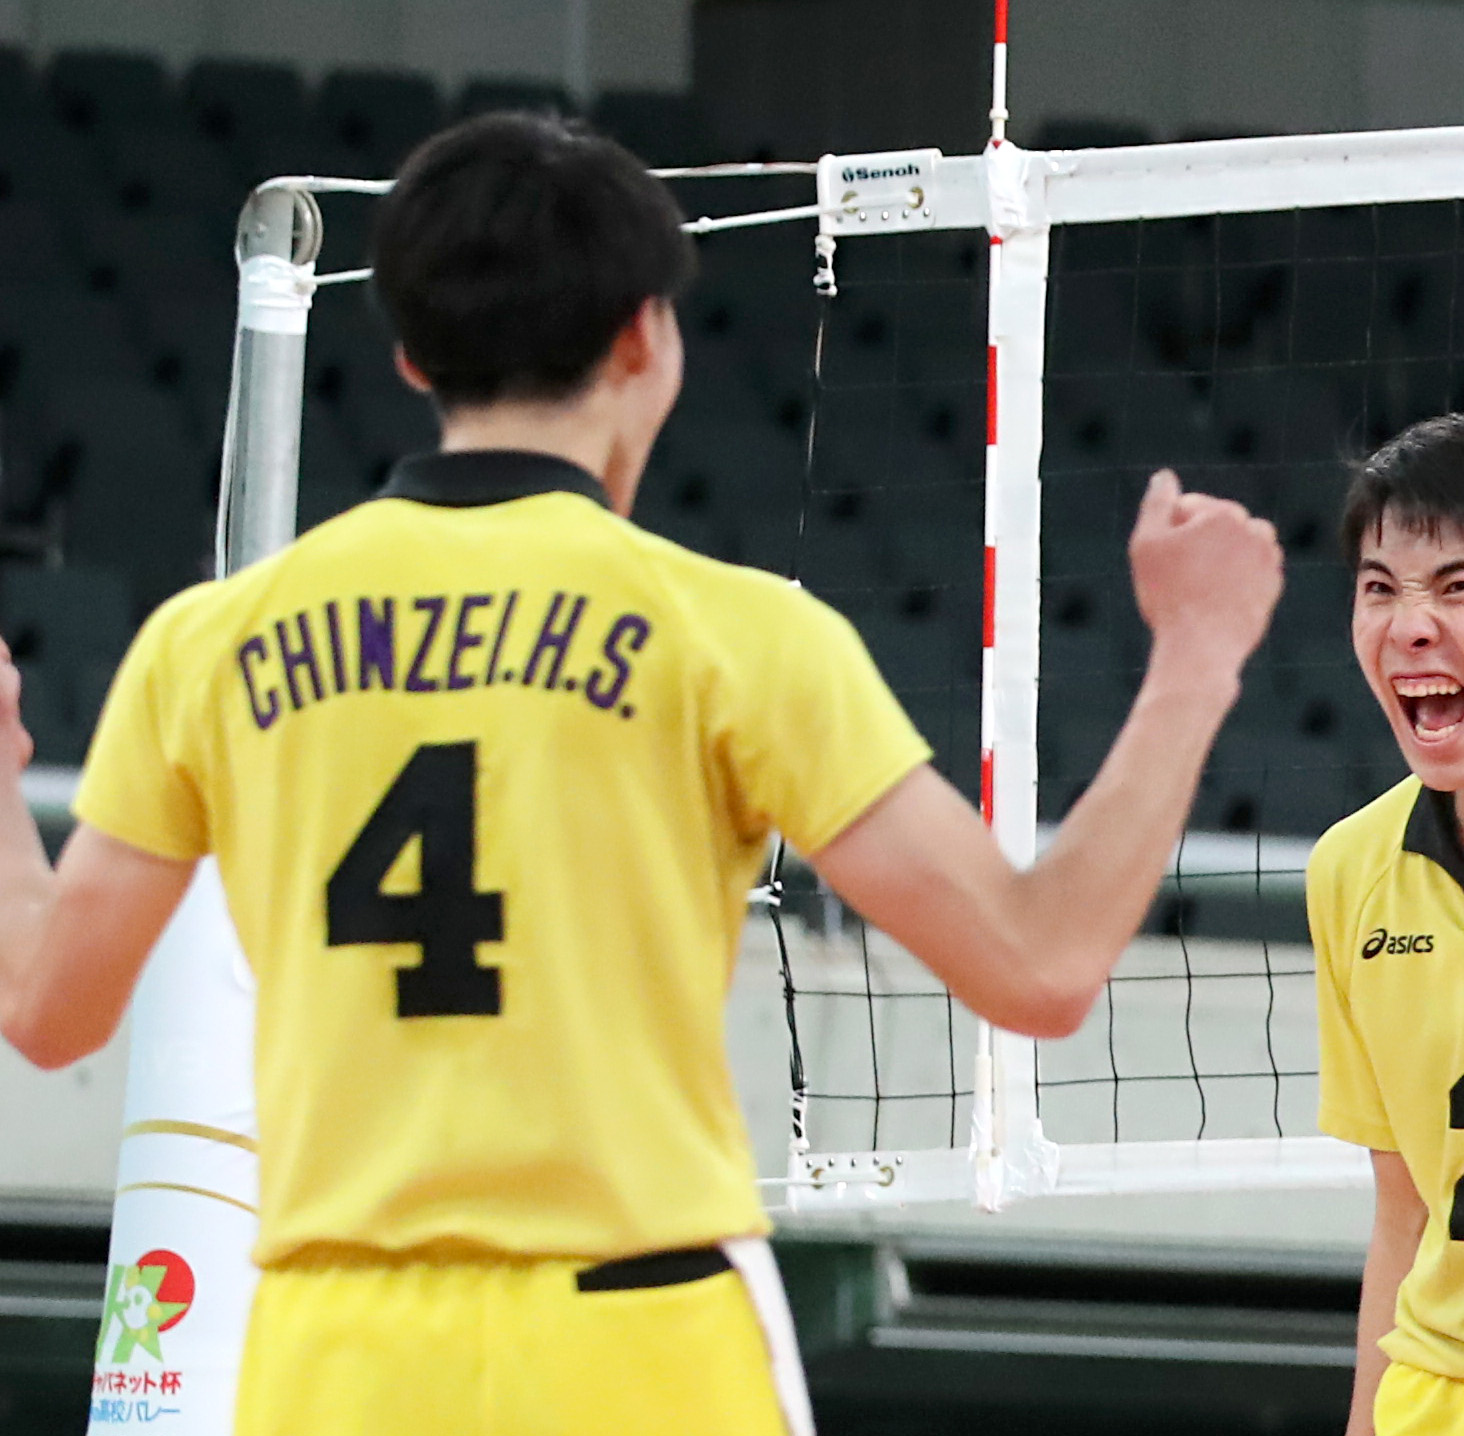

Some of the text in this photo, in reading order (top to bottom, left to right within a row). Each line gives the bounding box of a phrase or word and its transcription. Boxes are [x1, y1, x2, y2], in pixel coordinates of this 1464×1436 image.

[856, 164, 920, 180] Senoh
[237, 589, 653, 732] CHINZEI.H.S.
[325, 740, 507, 1018] 4
